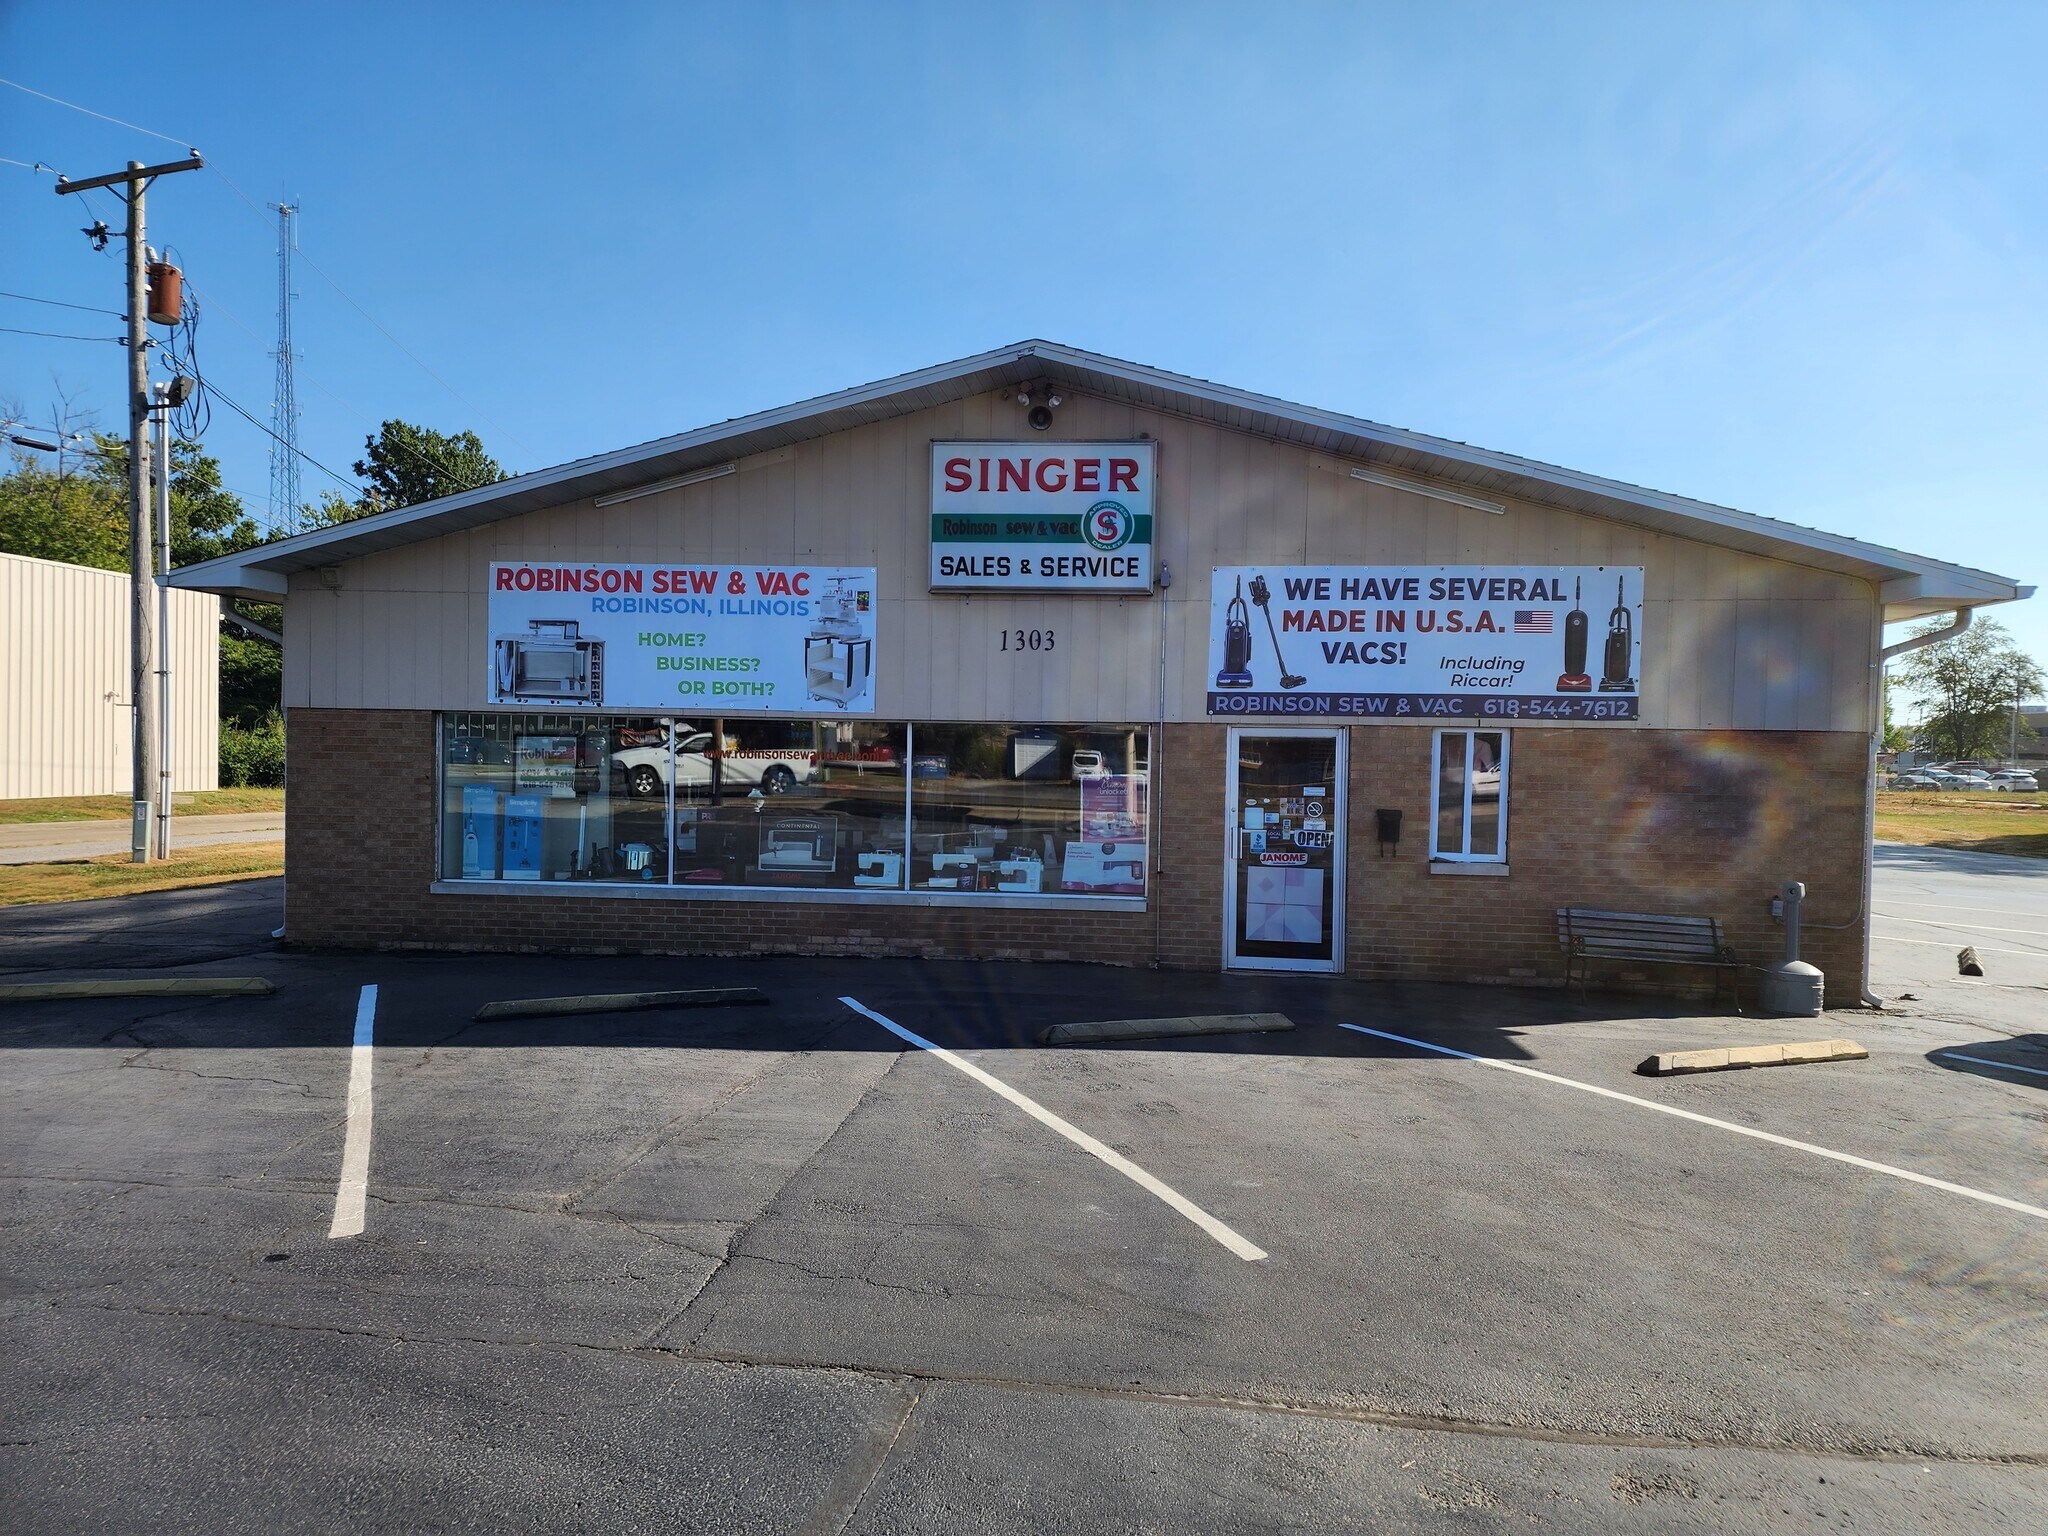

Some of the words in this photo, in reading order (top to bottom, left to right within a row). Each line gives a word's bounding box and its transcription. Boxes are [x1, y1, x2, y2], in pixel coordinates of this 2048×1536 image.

[944, 457, 1140, 492] SINGER
[1089, 502, 1129, 518] APPROVED
[943, 518, 997, 535] Robinson
[1006, 521, 1035, 535] sew
[1036, 520, 1048, 536] &
[1050, 520, 1078, 535] vac
[1097, 511, 1118, 541] S
[1091, 540, 1123, 550] DEALER
[940, 556, 1010, 577] SALES
[1020, 559, 1032, 575] &
[1040, 557, 1139, 577] SERVICE
[496, 567, 646, 593] ROBINSON
[652, 570, 718, 594] SEW
[727, 571, 747, 596] &
[755, 572, 811, 596] VAC
[1283, 577, 1330, 601] WE
[1340, 577, 1420, 601] HAVE
[1428, 577, 1567, 601] SEVERAL
[591, 597, 712, 617] ROBINSON,
[719, 599, 810, 616] ILLINOIS
[1282, 610, 1370, 633] MADE
[1376, 610, 1405, 633] IN
[1415, 610, 1506, 634] U.S.A.
[637, 631, 706, 647] HOME?
[1000, 629, 1055, 651] 1303
[1321, 641, 1408, 665] VACS!
[656, 656, 761, 672] BUSINESS?
[1440, 655, 1525, 673] Including
[678, 680, 708, 696] OR
[712, 681, 775, 697] BOTH?
[1450, 674, 1514, 689] Riccar!
[1215, 696, 1331, 712] ROBINSON
[1338, 697, 1390, 713] SEW
[1396, 697, 1411, 714] &
[1418, 697, 1463, 714] VAC
[1483, 699, 1630, 717] 618-544-7612
[1298, 831, 1330, 847] OPEN
[1261, 853, 1306, 862] JANOME
